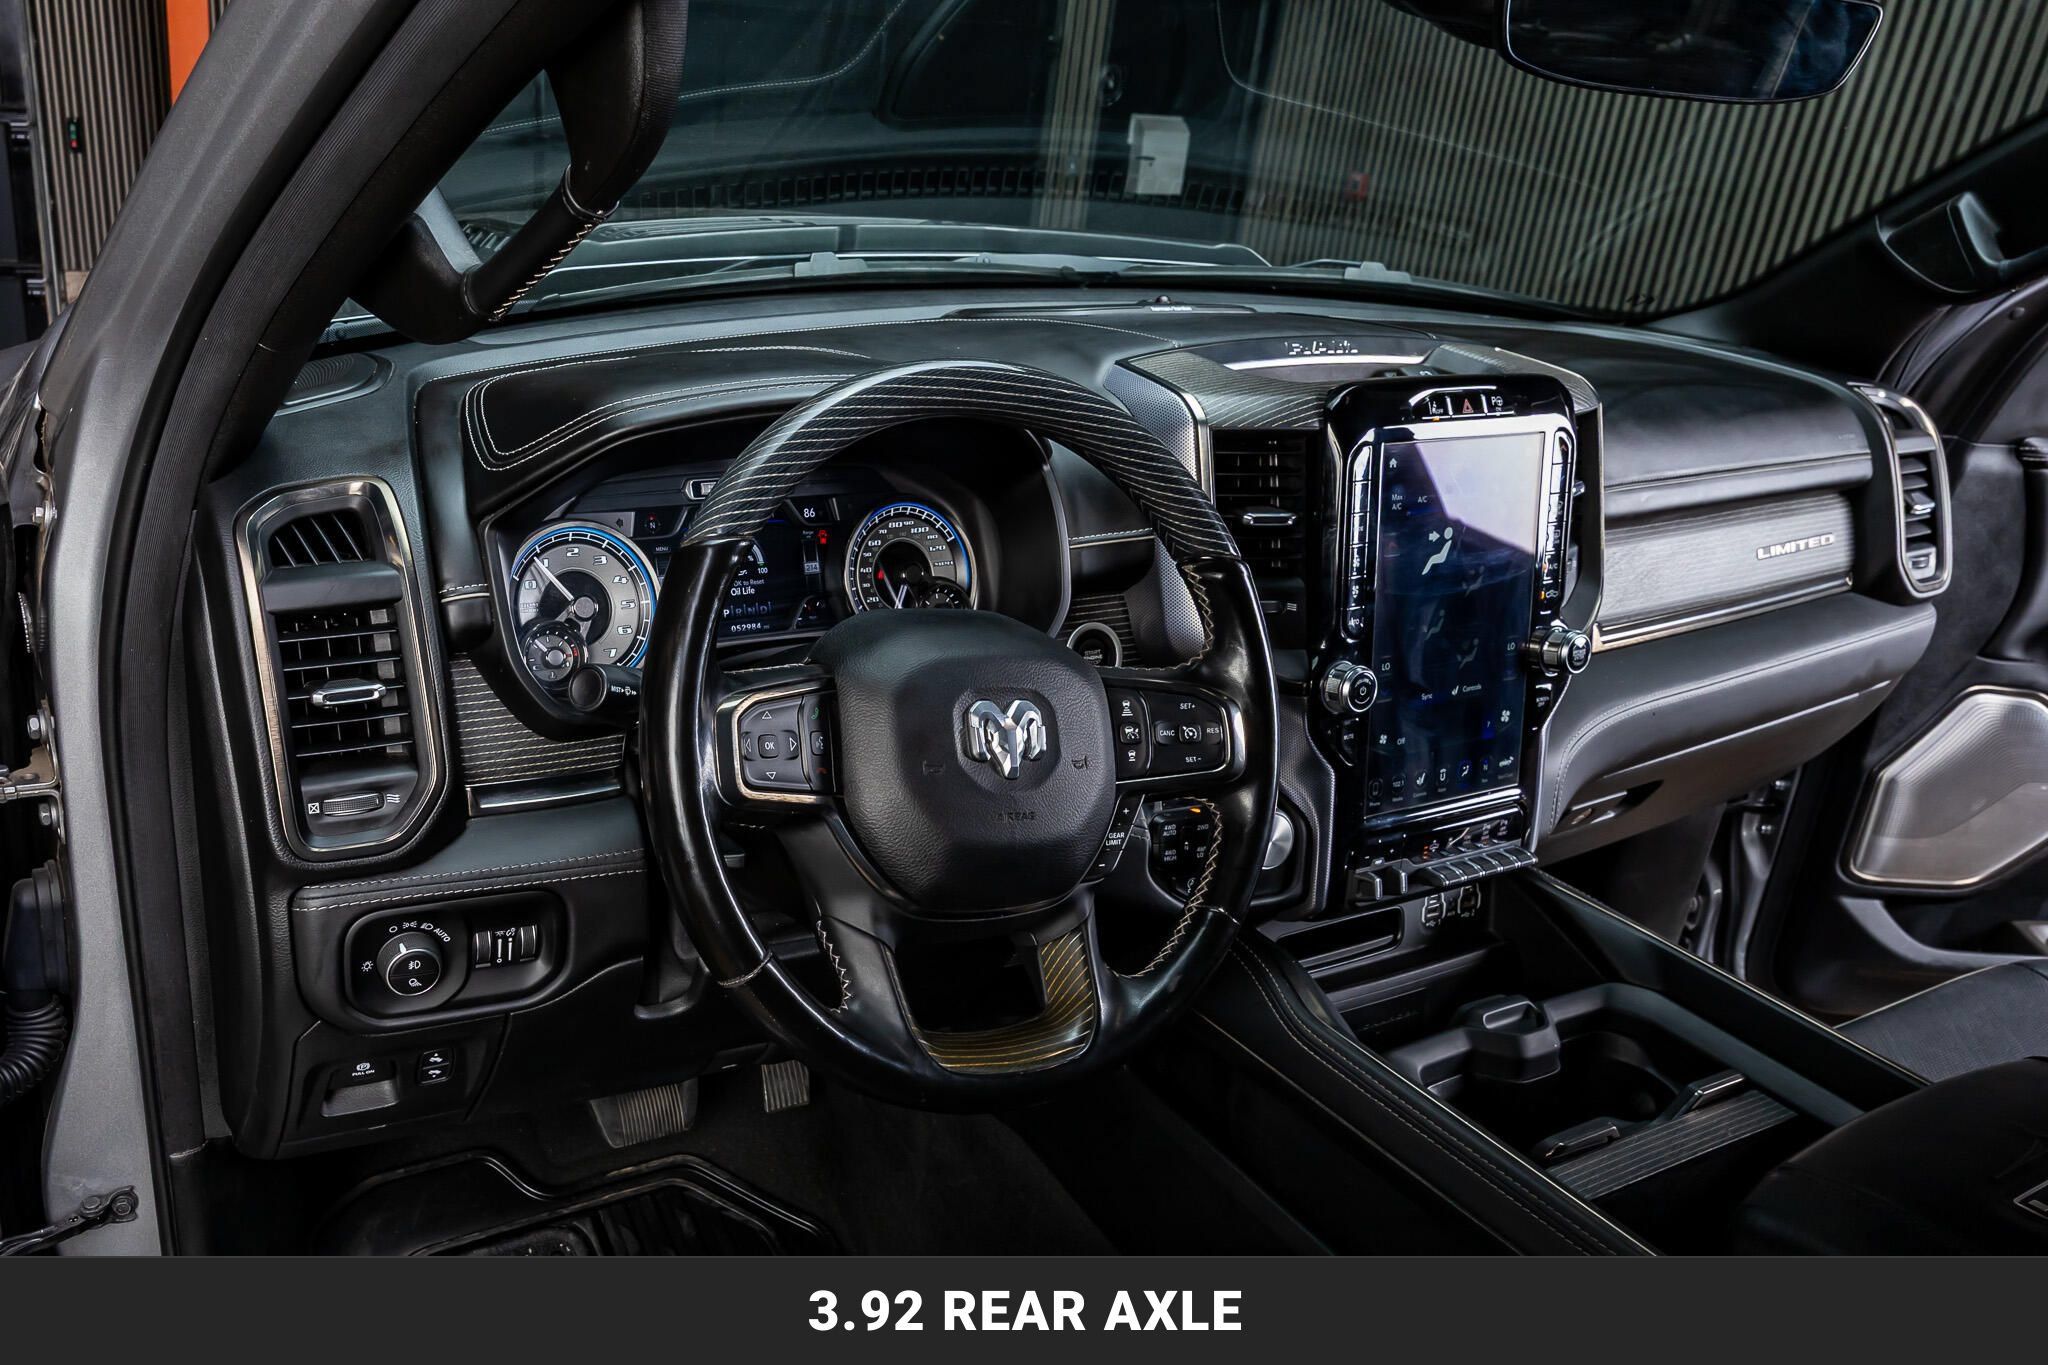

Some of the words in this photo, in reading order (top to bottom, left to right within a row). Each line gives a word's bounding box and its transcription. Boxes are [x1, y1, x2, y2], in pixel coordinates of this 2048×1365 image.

[803, 507, 816, 518] 86
[867, 539, 881, 547] 60
[1756, 533, 1835, 560] LIMITED
[566, 547, 580, 557] 2
[593, 555, 608, 565] 3
[524, 579, 537, 590] 0
[612, 575, 629, 585] 4
[730, 587, 741, 596] Oil
[742, 586, 756, 595] Life
[620, 600, 636, 609] 5
[617, 624, 633, 635] 6
[731, 622, 761, 632] 052984
[1507, 642, 1516, 651] LO
[603, 647, 618, 658] 7
[1381, 662, 1391, 671] LO
[610, 685, 622, 693] MIST
[1421, 693, 1433, 701] Sync
[1159, 729, 1176, 737] CANC
[764, 742, 775, 750] OK
[1108, 831, 1125, 839] GEAR
[1105, 838, 1122, 846] LIMIT
[433, 927, 451, 942] AUTO
